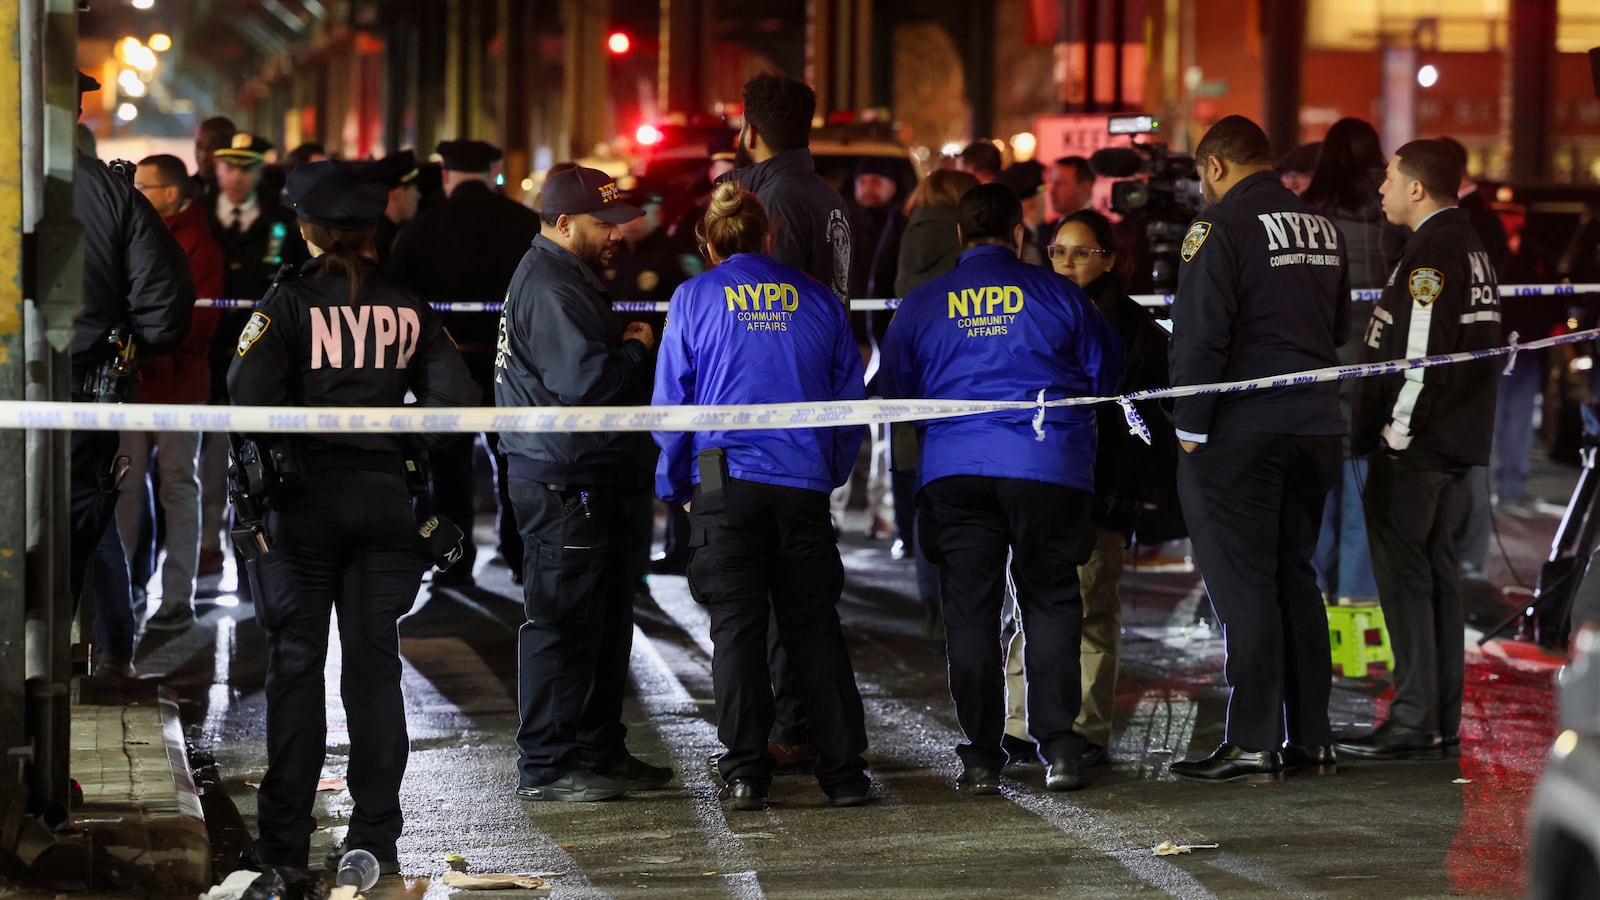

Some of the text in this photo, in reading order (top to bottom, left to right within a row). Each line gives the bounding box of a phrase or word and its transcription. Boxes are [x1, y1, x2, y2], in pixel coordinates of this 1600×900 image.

[1257, 211, 1338, 251] NYPD
[1270, 253, 1306, 268] COMMUNITY
[1467, 251, 1498, 284] NY
[724, 282, 799, 312] NYPD
[948, 285, 1025, 319] NYPD
[737, 311, 793, 321] COMMUNITY
[746, 321, 788, 332] AFFAIRS
[957, 315, 1015, 329] COMMUNITY
[309, 305, 421, 370] NYPD
[966, 325, 1009, 338] AFFAIRS
